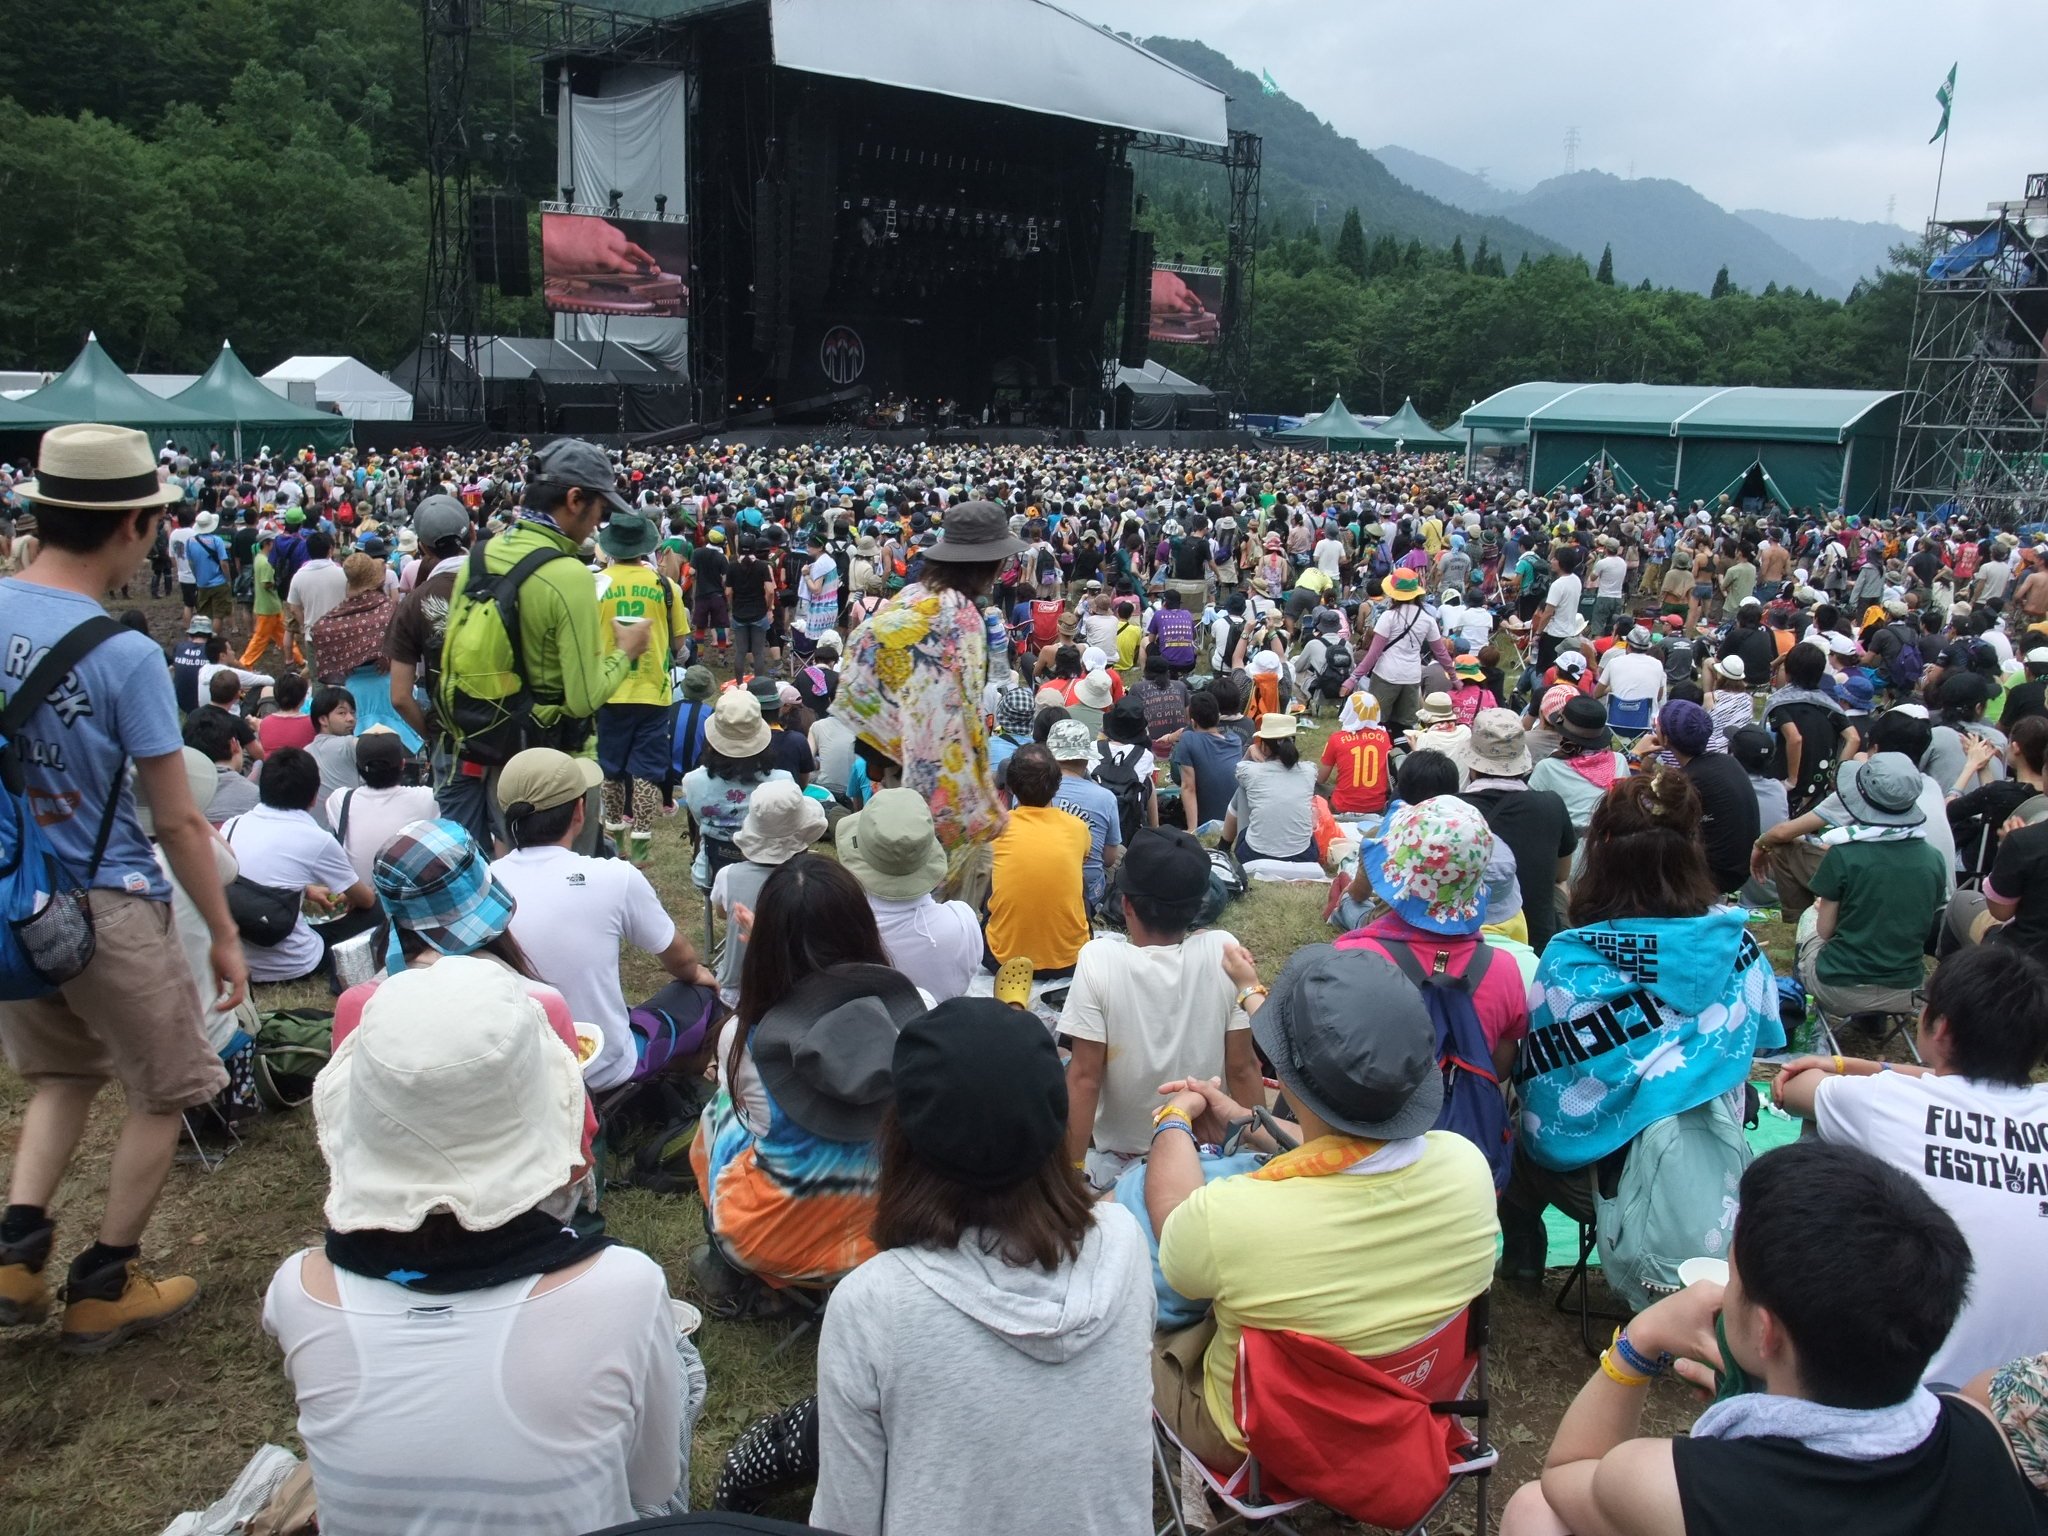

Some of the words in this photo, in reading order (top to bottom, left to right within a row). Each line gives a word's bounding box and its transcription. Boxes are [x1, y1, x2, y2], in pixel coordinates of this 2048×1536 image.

[601, 585, 626, 603] UJI
[632, 585, 664, 604] ROCK
[616, 600, 645, 617] 02
[184, 648, 202, 656] AND
[1340, 734, 1359, 744] FUJI
[1362, 732, 1385, 744] ROCK
[1350, 744, 1379, 788] 10
[1925, 1104, 1998, 1148] FUJI
[2004, 1116, 2048, 1154] ROC
